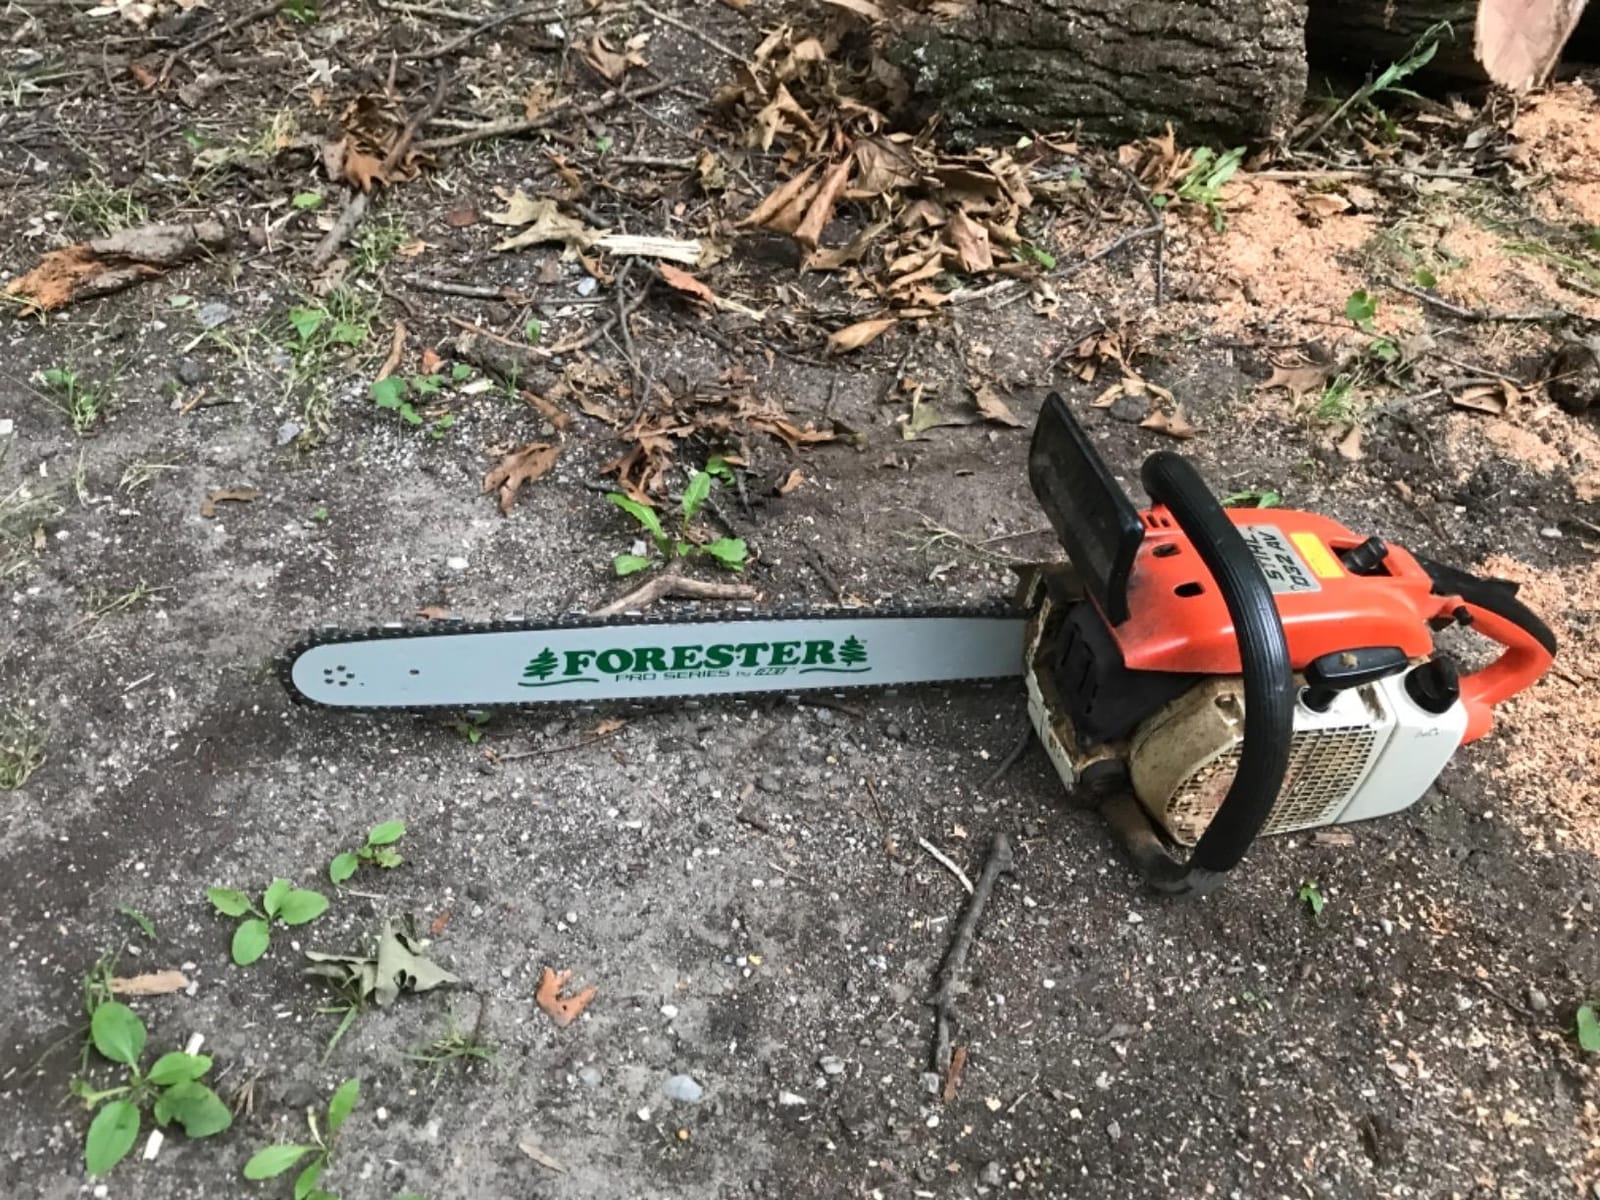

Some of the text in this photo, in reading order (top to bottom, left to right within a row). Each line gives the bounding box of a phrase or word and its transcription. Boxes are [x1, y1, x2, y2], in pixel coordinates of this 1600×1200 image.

[1246, 533, 1285, 582] STIHL
[1258, 531, 1311, 587] 032 AV
[562, 640, 836, 674] FORESTER
[615, 672, 657, 683] PRO
[663, 670, 730, 681] SERIES
